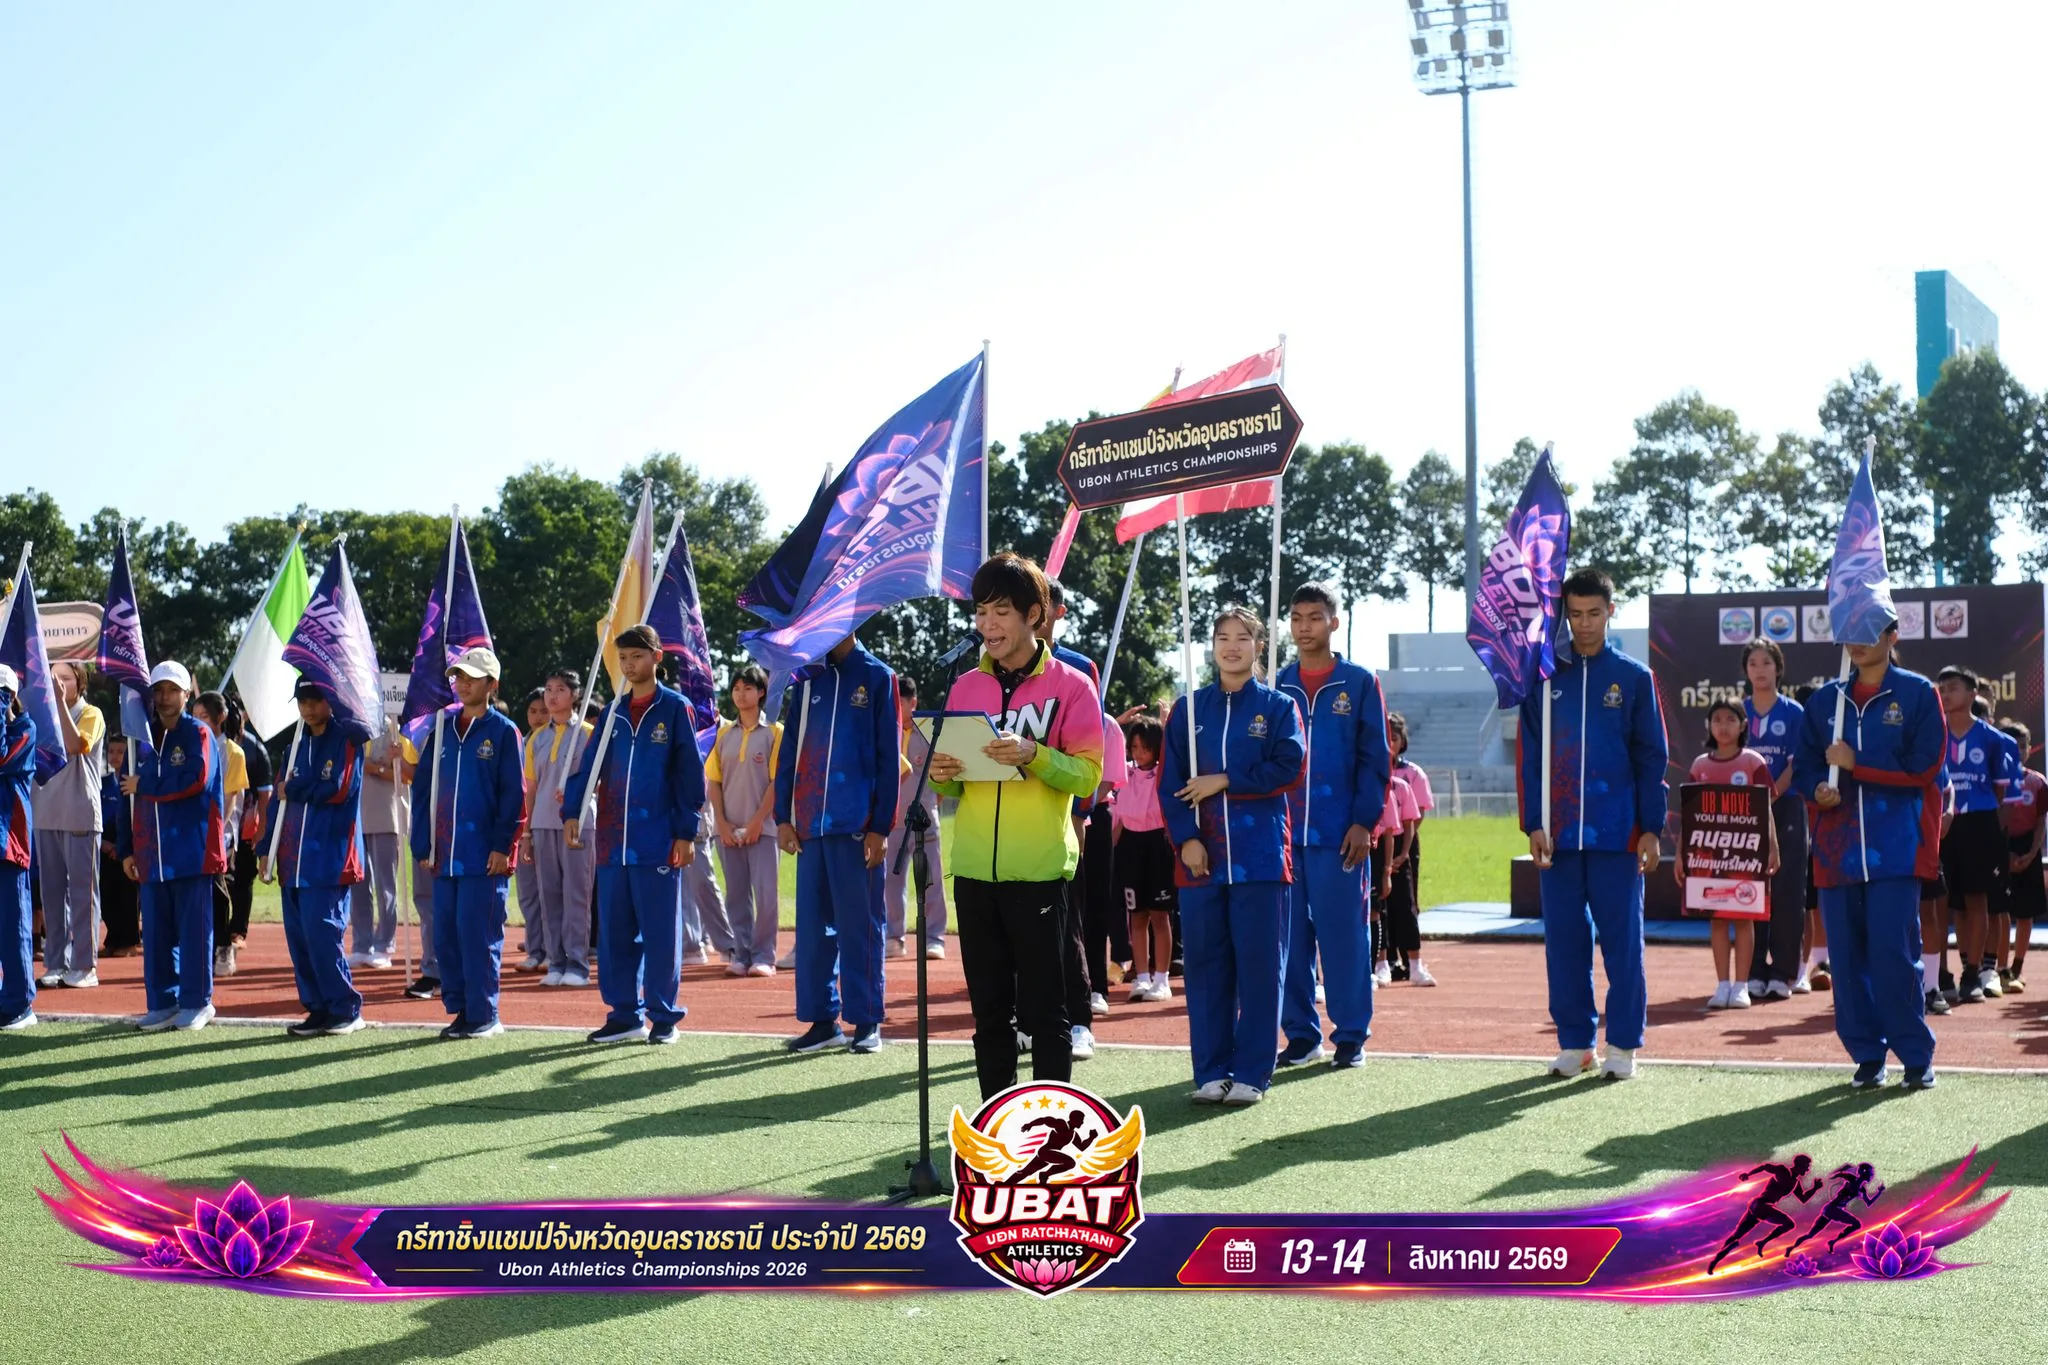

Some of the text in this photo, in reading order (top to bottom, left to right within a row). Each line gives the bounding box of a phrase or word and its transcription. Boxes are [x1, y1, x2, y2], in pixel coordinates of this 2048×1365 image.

[1079, 442, 1278, 488] UBON ATHLETICS CHAMPIONSHIPS
[1702, 791, 1751, 815] UB MOVE
[1694, 813, 1758, 825] YOU BE MOVE
[1690, 830, 1761, 858] คนอุบล
